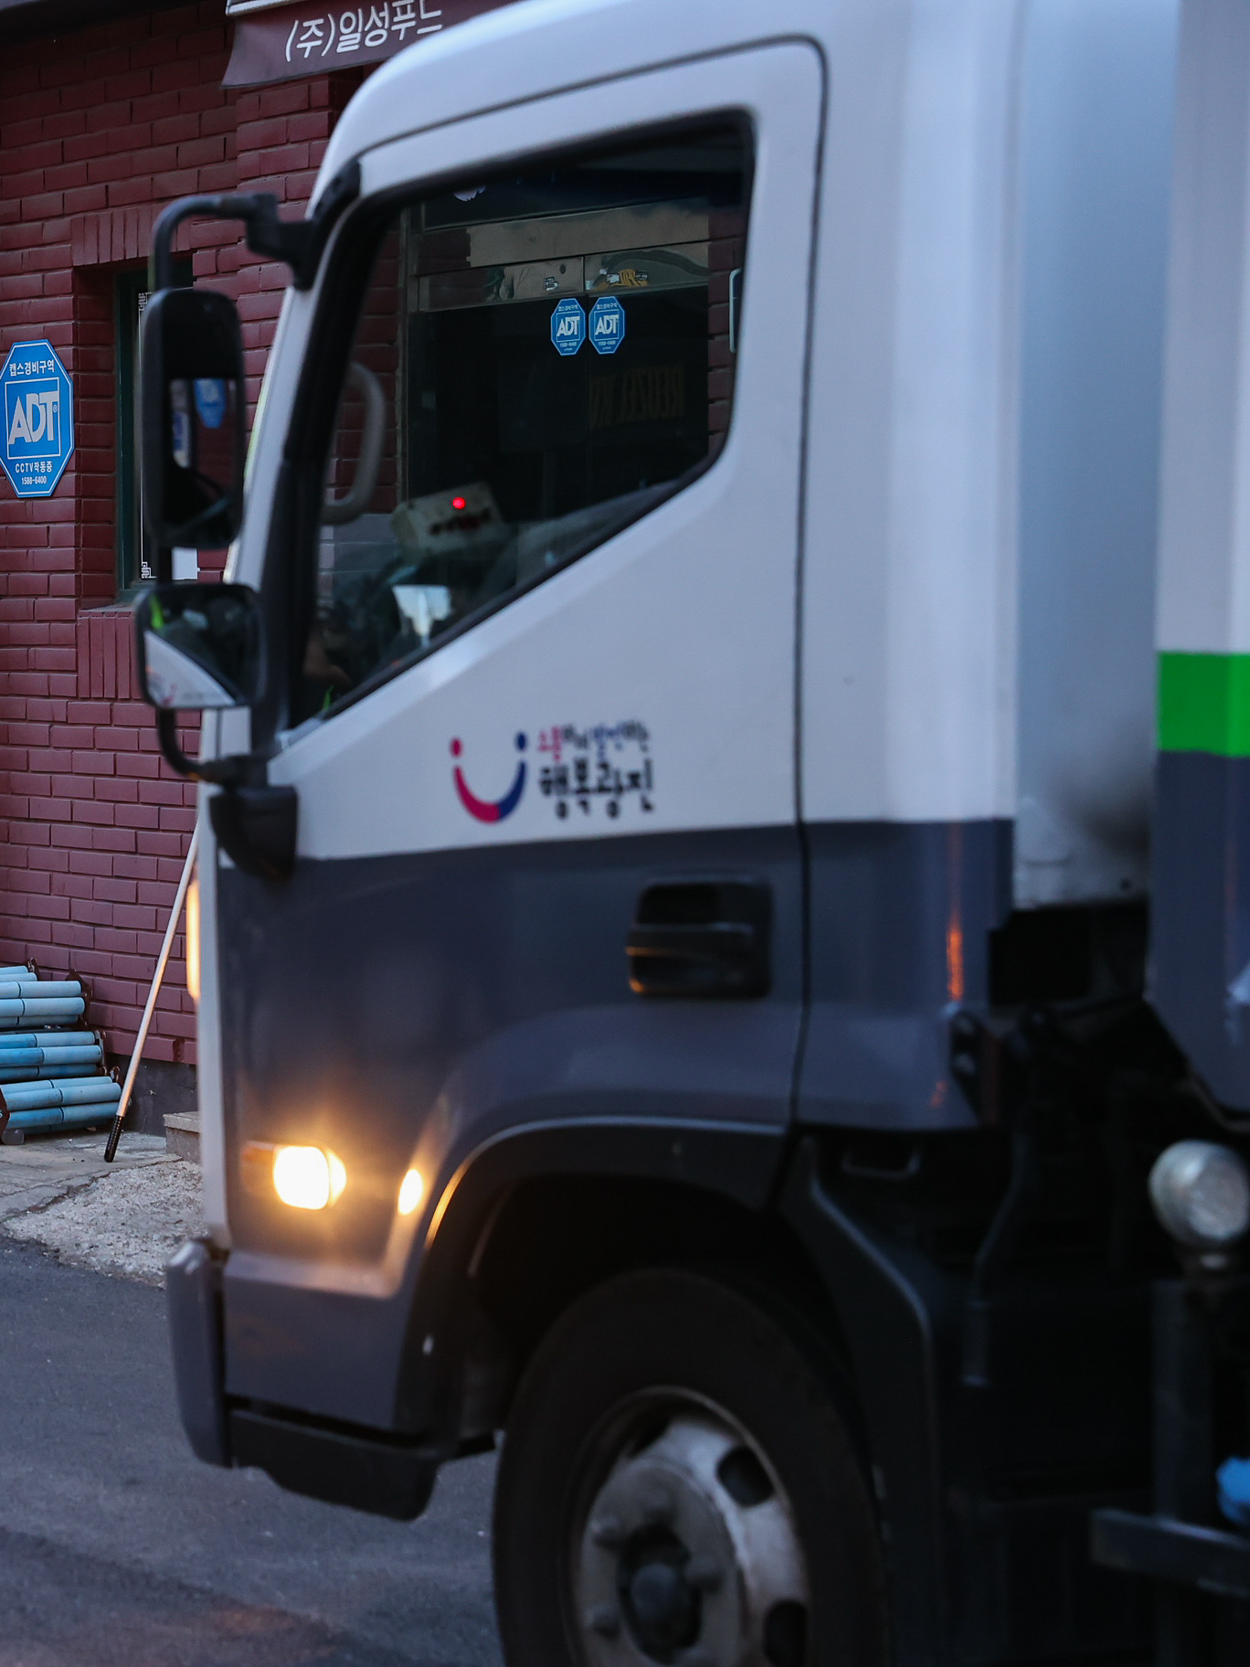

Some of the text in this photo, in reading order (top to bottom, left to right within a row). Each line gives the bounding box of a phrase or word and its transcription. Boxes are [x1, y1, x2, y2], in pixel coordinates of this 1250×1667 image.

[556, 315, 580, 337] ADT
[594, 314, 619, 336] ADT
[9, 359, 55, 377] 캡스경비구역
[8, 390, 59, 445] ADT
[15, 461, 53, 473] CCTV작동중
[21, 475, 47, 485] 1588-6400
